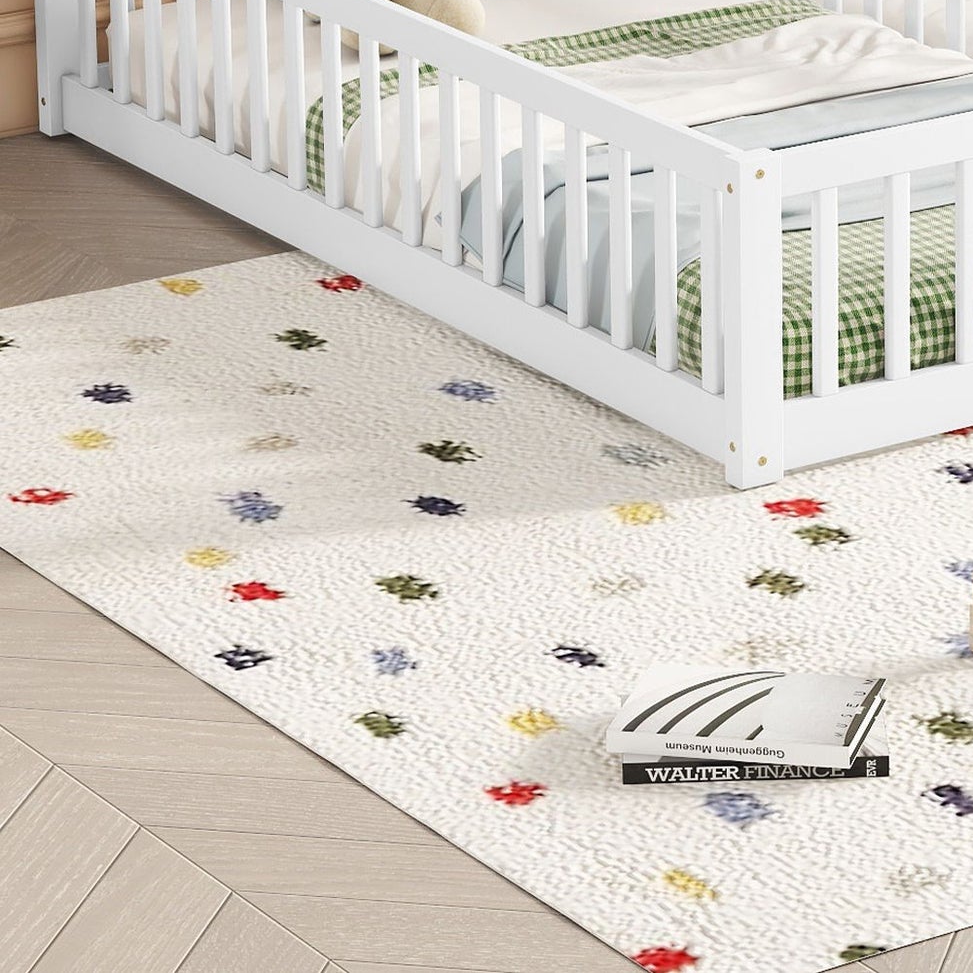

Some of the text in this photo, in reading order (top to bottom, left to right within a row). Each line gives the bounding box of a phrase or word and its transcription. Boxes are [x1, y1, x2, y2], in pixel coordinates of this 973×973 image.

[665, 742, 785, 759] Guggenheim Museum
[645, 764, 845, 783] WALTER FINANCE
